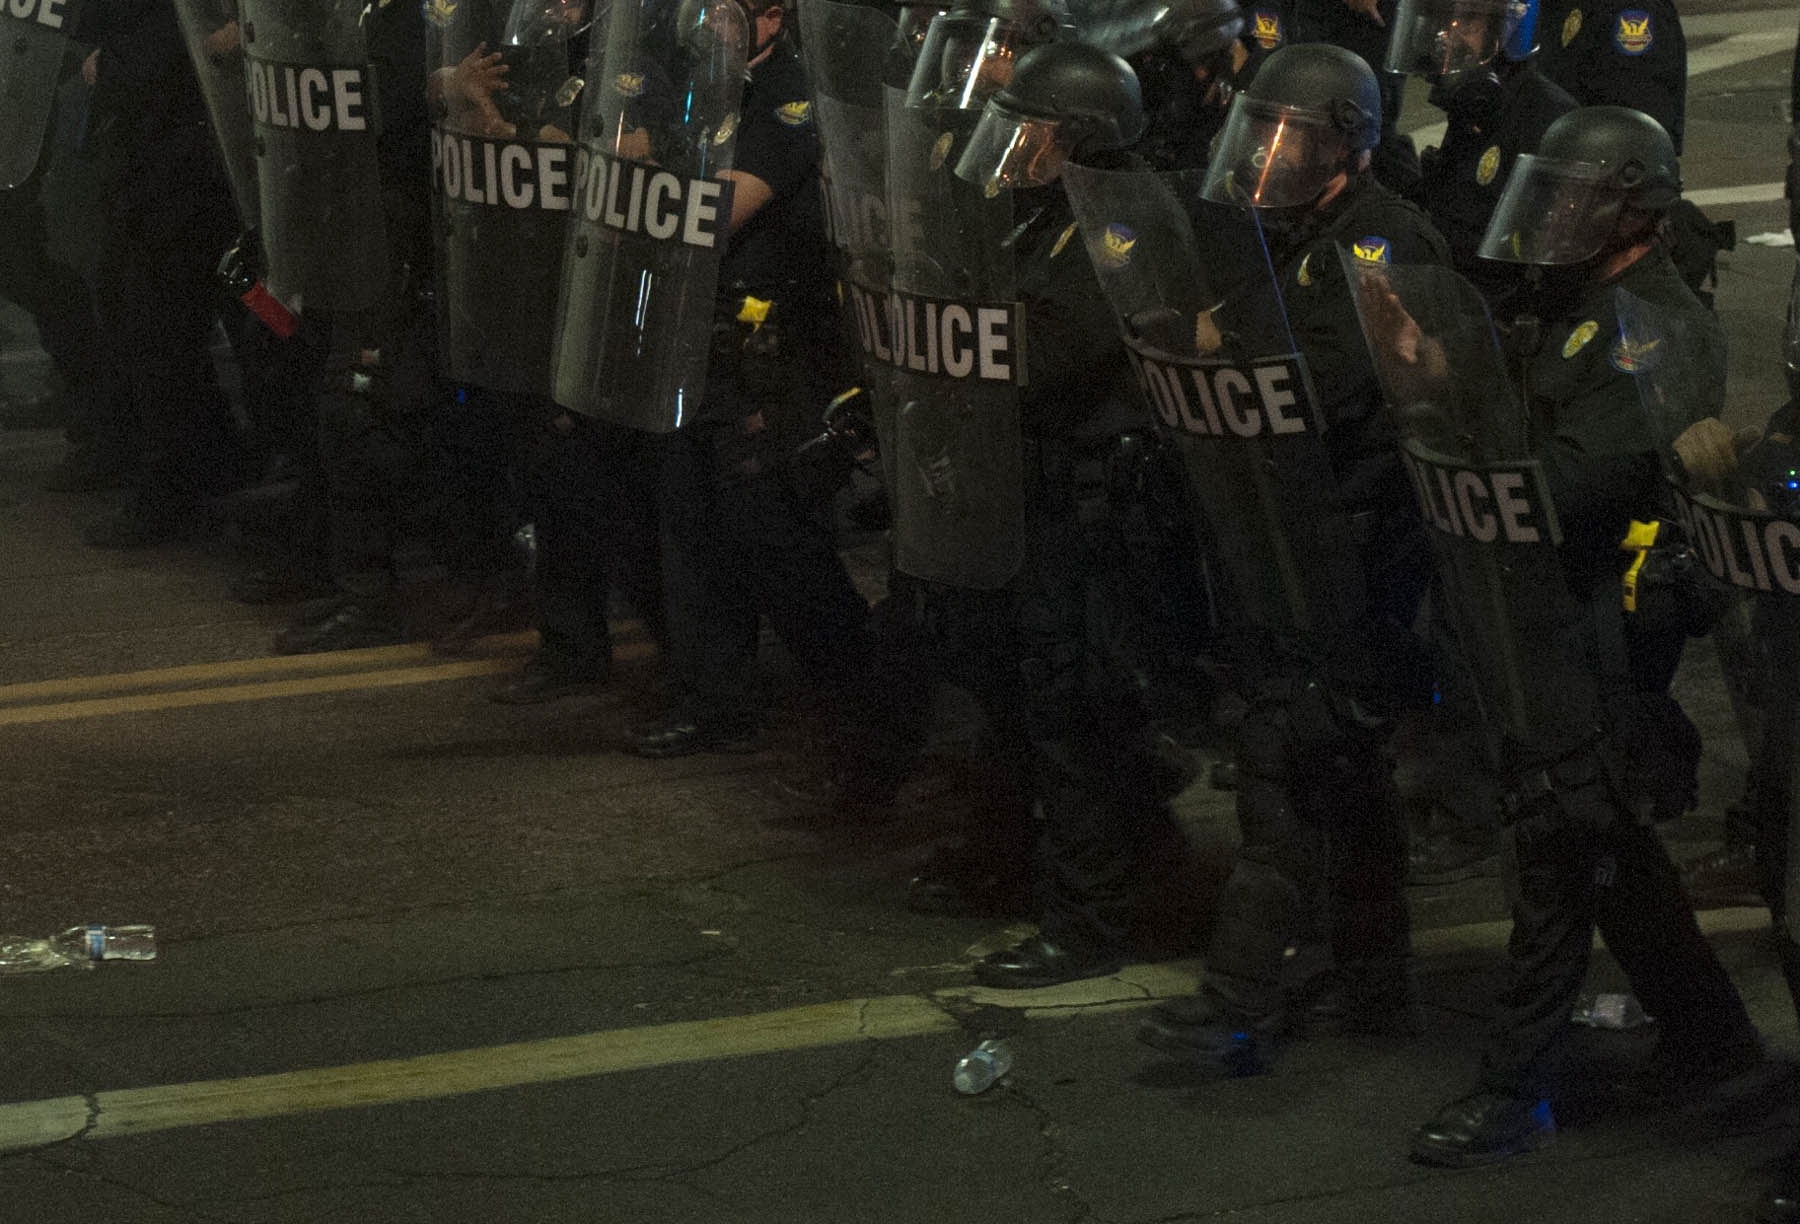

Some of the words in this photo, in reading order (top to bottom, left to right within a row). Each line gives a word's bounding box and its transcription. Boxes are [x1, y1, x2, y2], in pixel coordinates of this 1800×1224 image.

[432, 129, 570, 209] POLICE
[572, 147, 721, 248] POLICE
[888, 293, 1011, 381] OLICE
